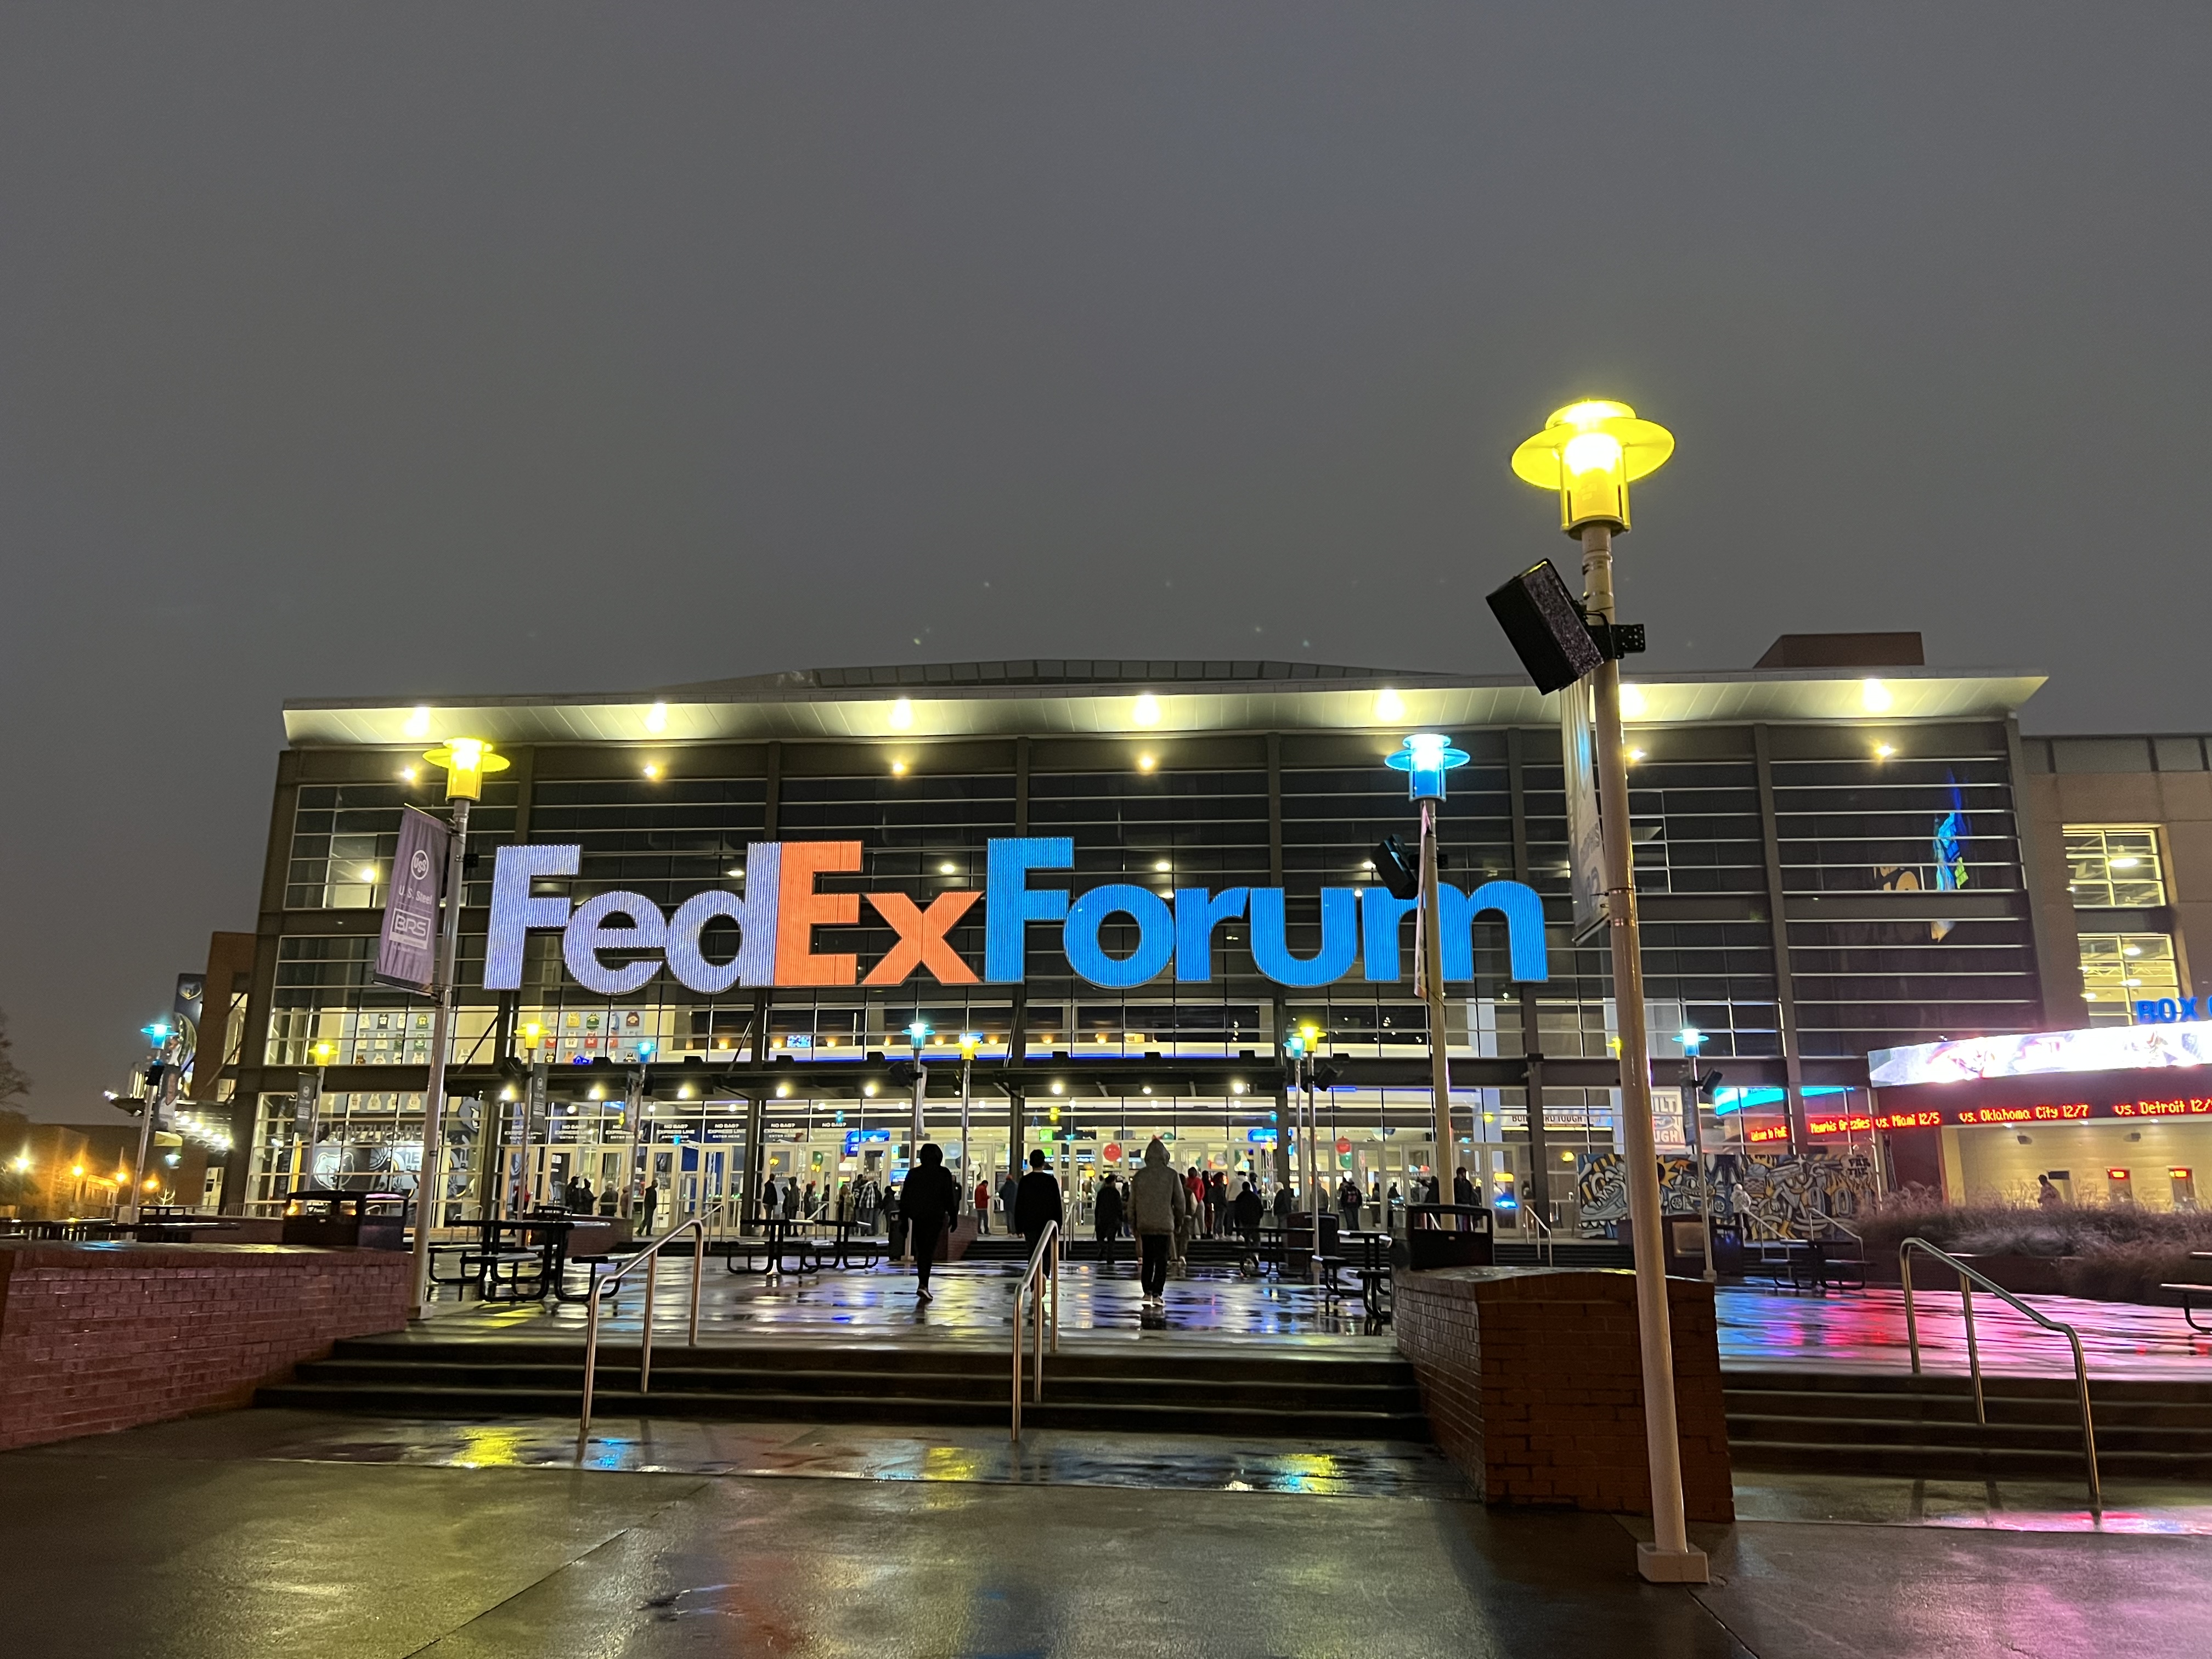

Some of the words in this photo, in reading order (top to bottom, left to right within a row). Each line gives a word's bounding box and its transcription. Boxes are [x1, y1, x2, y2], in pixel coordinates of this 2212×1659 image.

[416, 890, 433, 905] Steel
[394, 915, 426, 937] BRS
[2136, 997, 2199, 1023] BOX
[1651, 1097, 1676, 1113] ILT
[1959, 1111, 1977, 1122] vs.
[1980, 1108, 2031, 1121] Oklahoma
[2036, 1105, 2058, 1119] City
[2063, 1104, 2089, 1118] 12/7
[2114, 1105, 2135, 1115] vs.
[2140, 1100, 2185, 1115] Detroit
[2191, 1098, 2212, 1113] 12/
[1811, 1120, 1836, 1134] Memphis
[1839, 1118, 1870, 1132] Grzzlies
[1876, 1118, 1889, 1128] vs.
[1892, 1114, 1916, 1126] Miami
[1918, 1112, 1939, 1124] 12/5
[1654, 1130, 1677, 1142] UGH
